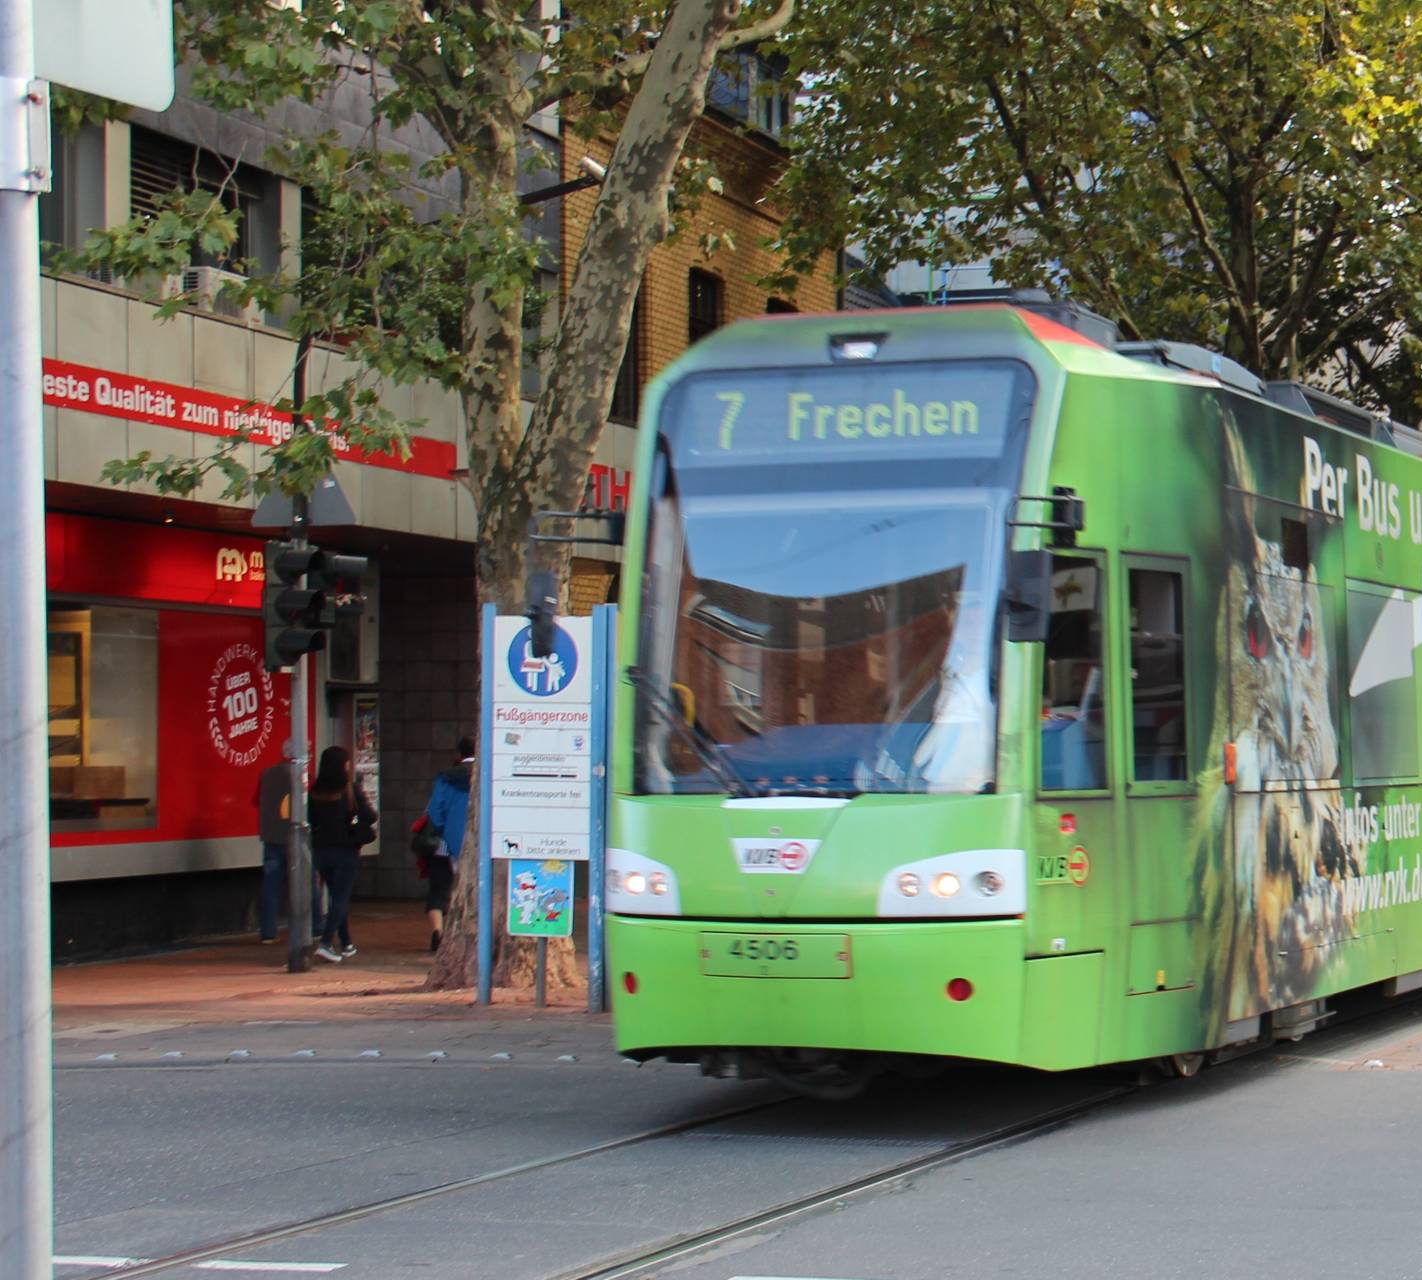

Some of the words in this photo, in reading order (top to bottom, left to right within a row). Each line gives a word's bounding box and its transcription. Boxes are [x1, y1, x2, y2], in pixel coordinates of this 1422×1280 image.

[95, 376, 176, 418] Qualität
[182, 399, 219, 427] zum
[715, 391, 745, 450] 7
[787, 388, 980, 441] Frechen
[1302, 435, 1348, 519] Per
[1355, 453, 1401, 540] Bus
[207, 643, 258, 713] HANDWERK
[221, 686, 258, 721] 100
[225, 671, 251, 691] ÜBER
[228, 716, 259, 739] JAHRE
[228, 706, 275, 768] TRADITION
[495, 707, 589, 725] Fußgängerzone
[1339, 791, 1380, 845] Infos
[1384, 794, 1422, 841] unter
[728, 939, 800, 961] 4506
